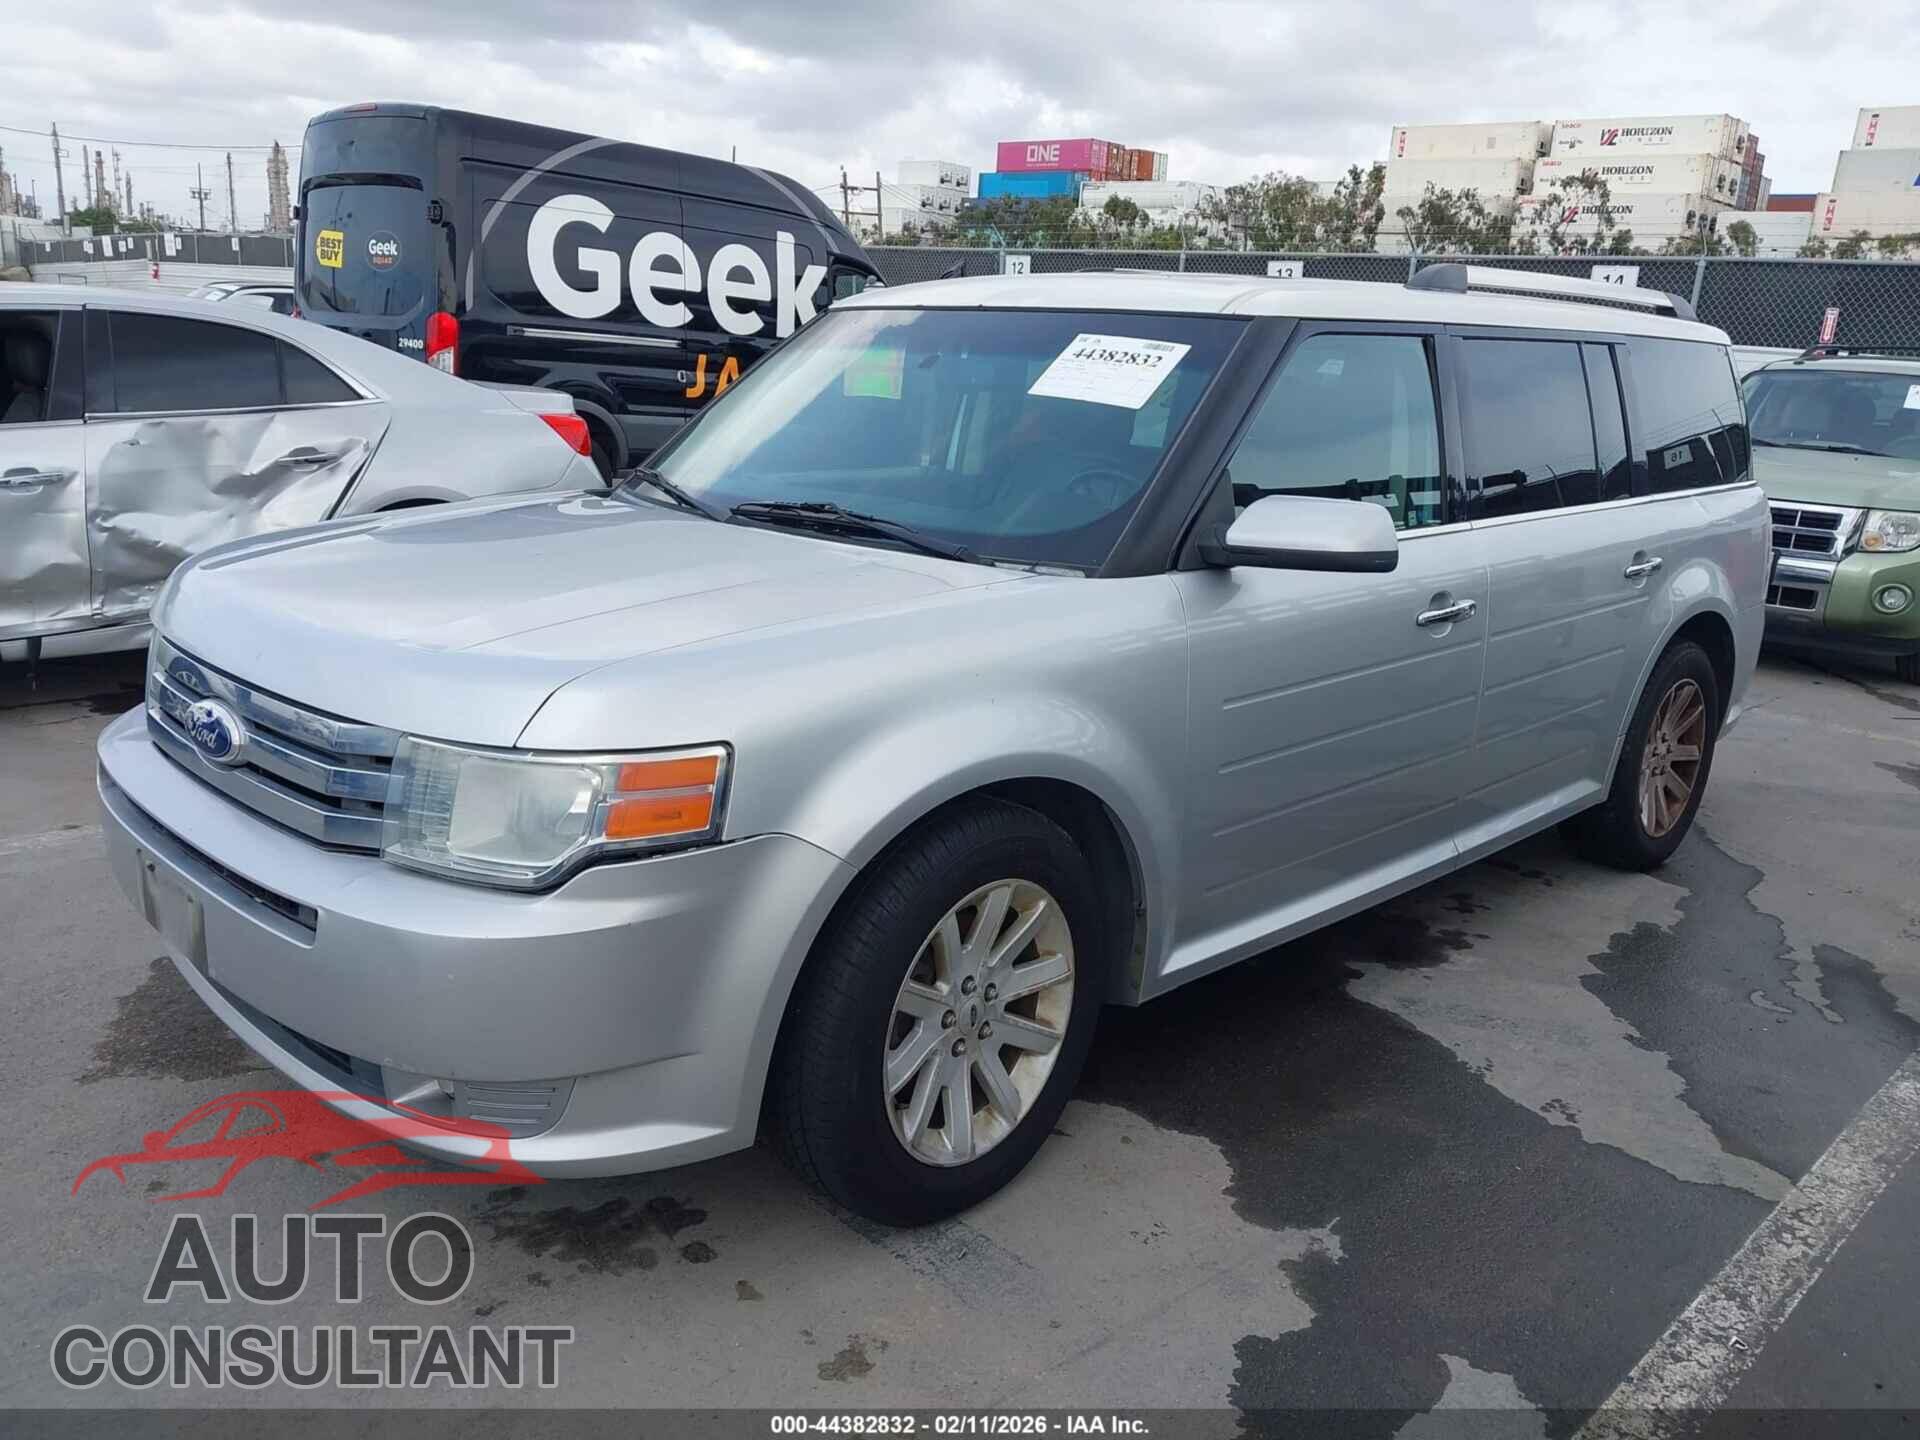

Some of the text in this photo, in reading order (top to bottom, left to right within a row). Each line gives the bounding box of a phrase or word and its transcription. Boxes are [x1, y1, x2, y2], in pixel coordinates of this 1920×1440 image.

[1026, 144, 1060, 162] ONE
[320, 236, 342, 250] BEST
[368, 239, 398, 256] Geek
[320, 249, 340, 262] BUY
[527, 194, 828, 338] Geek
[1011, 261, 1024, 275] 12
[398, 337, 424, 349] 29400
[1073, 348, 1163, 367] 44382832
